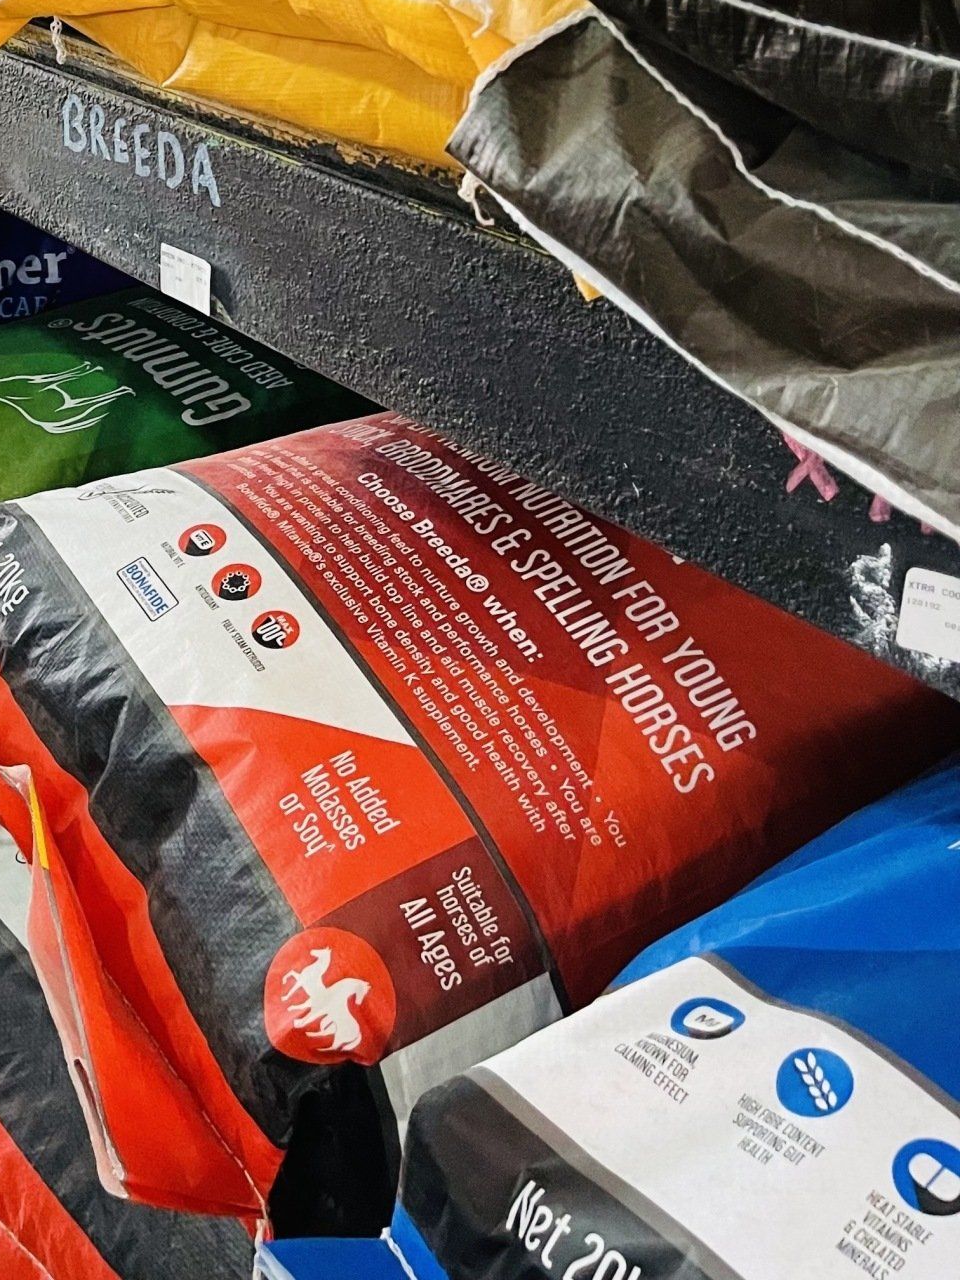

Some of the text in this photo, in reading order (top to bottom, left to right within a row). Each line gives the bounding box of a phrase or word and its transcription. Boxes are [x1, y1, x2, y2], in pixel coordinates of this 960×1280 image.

[62, 94, 222, 208] BREEDA
[241, 360, 294, 389] AGED
[375, 439, 513, 535] BROODMARES
[357, 472, 416, 522] Choose
[411, 518, 490, 593] Breeda®
[483, 594, 544, 663] when:
[491, 528, 532, 556] &
[126, 563, 170, 615] BONAFIDE
[276, 615, 294, 635] MAX
[508, 480, 758, 752] NUTRITION FOR YOUNG
[510, 550, 629, 667] SPELLING
[262, 483, 547, 834] You are wanting to support bone density and good health with
[290, 488, 303, 498] in
[297, 496, 332, 525] protein
[328, 523, 342, 535] to
[337, 533, 362, 555] help
[358, 553, 390, 583] build
[382, 582, 404, 604] top
[400, 603, 424, 629] line
[420, 629, 447, 655] and
[440, 655, 465, 677] aid
[458, 677, 501, 727] muscle
[497, 726, 550, 798] recovery
[545, 800, 577, 842] after
[308, 483, 344, 513] suitable
[341, 511, 359, 526] for
[352, 524, 398, 568] breeding
[393, 566, 424, 597] stock
[419, 597, 447, 622] and
[437, 622, 510, 706] performance
[506, 704, 548, 759] horses
[559, 777, 583, 814] You
[579, 816, 602, 847] are
[322, 571, 369, 624] exclusive
[366, 622, 407, 674] Vitamin
[403, 672, 421, 687] K
[413, 685, 478, 772] supplement.
[335, 483, 390, 535] conditioning
[387, 532, 415, 555] feed
[409, 552, 423, 568] to
[420, 567, 461, 611] nurture
[454, 611, 499, 657] growth
[495, 657, 524, 686] and
[518, 686, 594, 790] development
[603, 810, 628, 849] You
[605, 663, 715, 794] HORSES
[278, 793, 305, 816] or
[300, 763, 366, 852] Molasses
[329, 750, 401, 835] No Added
[400, 897, 463, 991] All Ages
[436, 886, 495, 968] horses of
[452, 866, 513, 966] Suitable for
[614, 1042, 690, 1105] CALMING EFFECT
[667, 1059, 690, 1083] FOR
[733, 1113, 806, 1167] SUPPORTING GUT
[737, 1093, 761, 1115] HIGH
[783, 1121, 826, 1158] CONTENT
[738, 1140, 774, 1166] HEALTH
[505, 1179, 572, 1270] Net
[836, 1238, 890, 1280] MINERALS
[854, 1227, 907, 1272] CHELATED
[863, 1210, 913, 1253] VITAMINS
[866, 1189, 935, 1246] HEAT STABLE
